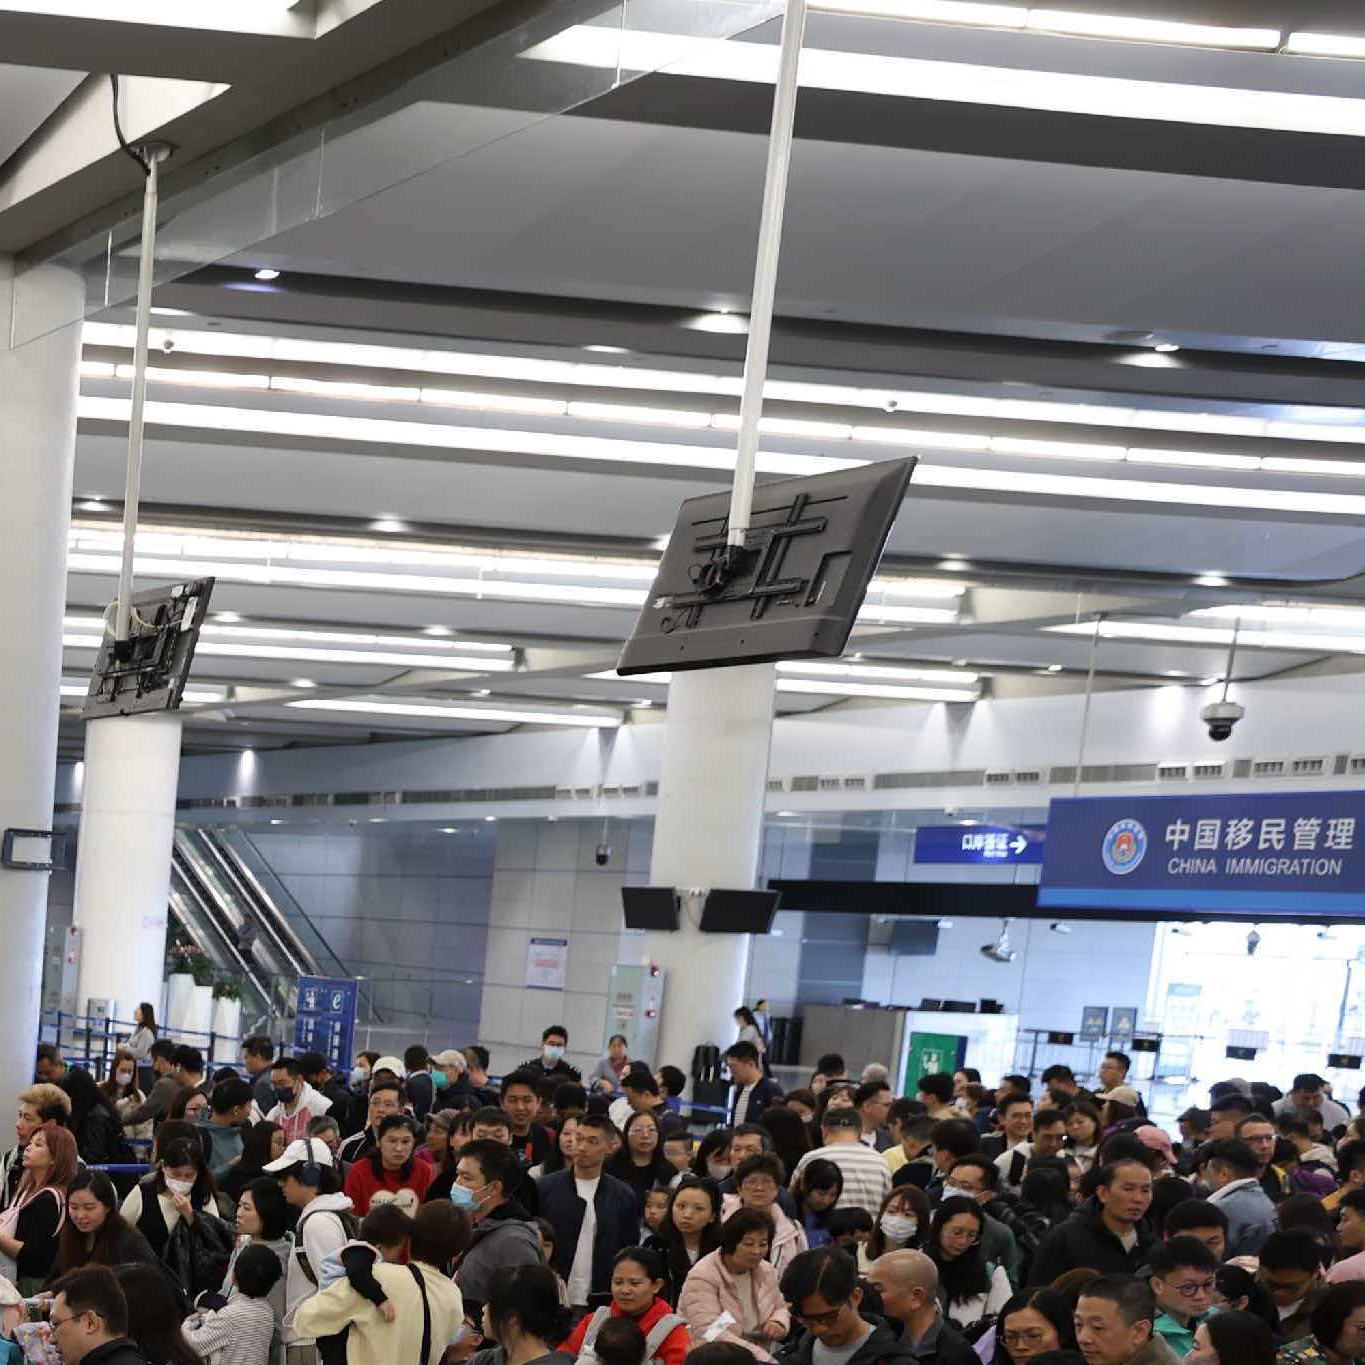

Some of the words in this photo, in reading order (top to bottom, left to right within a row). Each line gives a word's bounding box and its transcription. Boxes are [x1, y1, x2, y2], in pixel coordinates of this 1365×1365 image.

[1165, 817, 1356, 851] 中国移民管理
[1168, 857, 1217, 875] CHINA
[1225, 857, 1342, 876] IMMIGRATION
